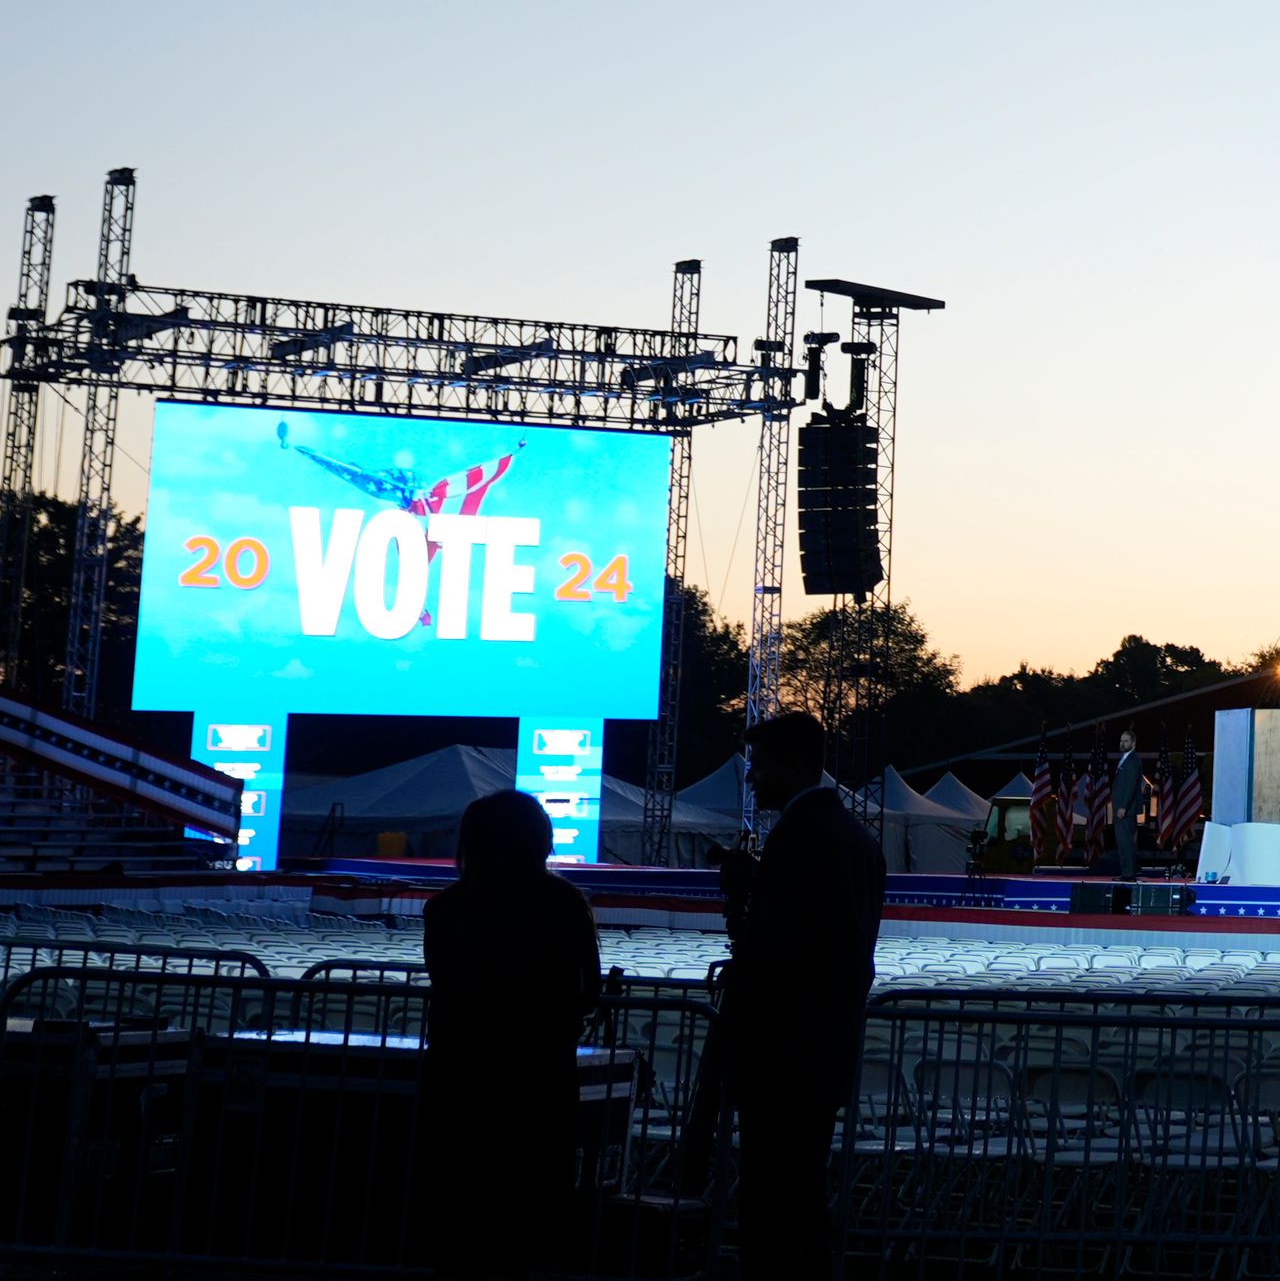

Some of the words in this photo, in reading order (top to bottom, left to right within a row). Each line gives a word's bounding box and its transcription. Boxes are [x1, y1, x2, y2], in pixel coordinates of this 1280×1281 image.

[178, 535, 270, 589] 20
[289, 506, 541, 641] VOTE
[555, 552, 633, 602] 24
